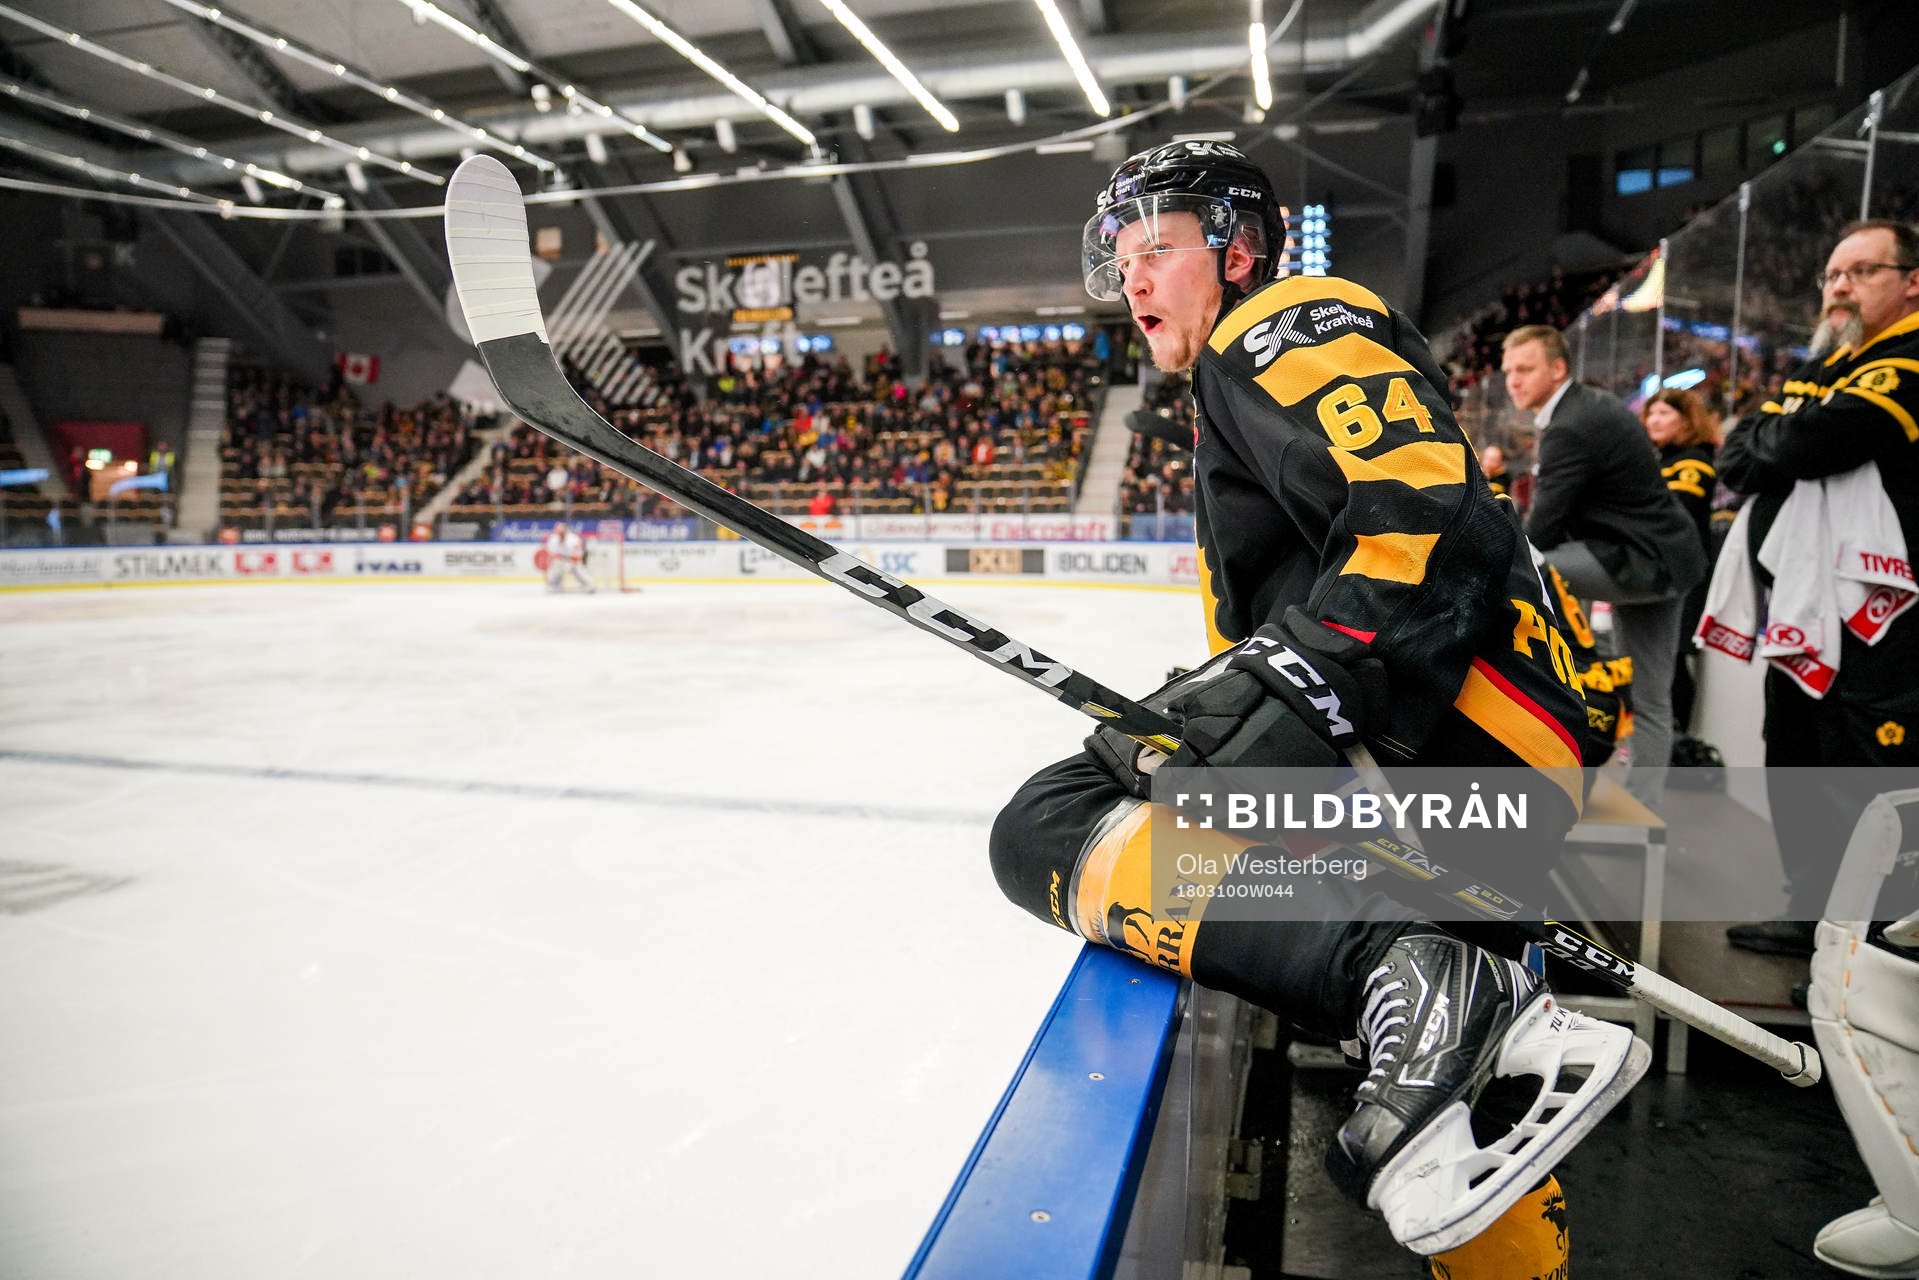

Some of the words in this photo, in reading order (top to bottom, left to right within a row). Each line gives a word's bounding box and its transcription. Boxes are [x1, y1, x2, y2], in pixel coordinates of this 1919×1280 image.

[1229, 187, 1262, 200] CCM
[675, 241, 935, 313] Sklefteå
[1243, 306, 1316, 368] SK
[1317, 377, 1435, 451] 64
[1059, 552, 1148, 575] BOLIDEN
[818, 552, 1073, 687] CCM
[1238, 636, 1354, 736] CCM
[1554, 928, 1635, 975] CCM
